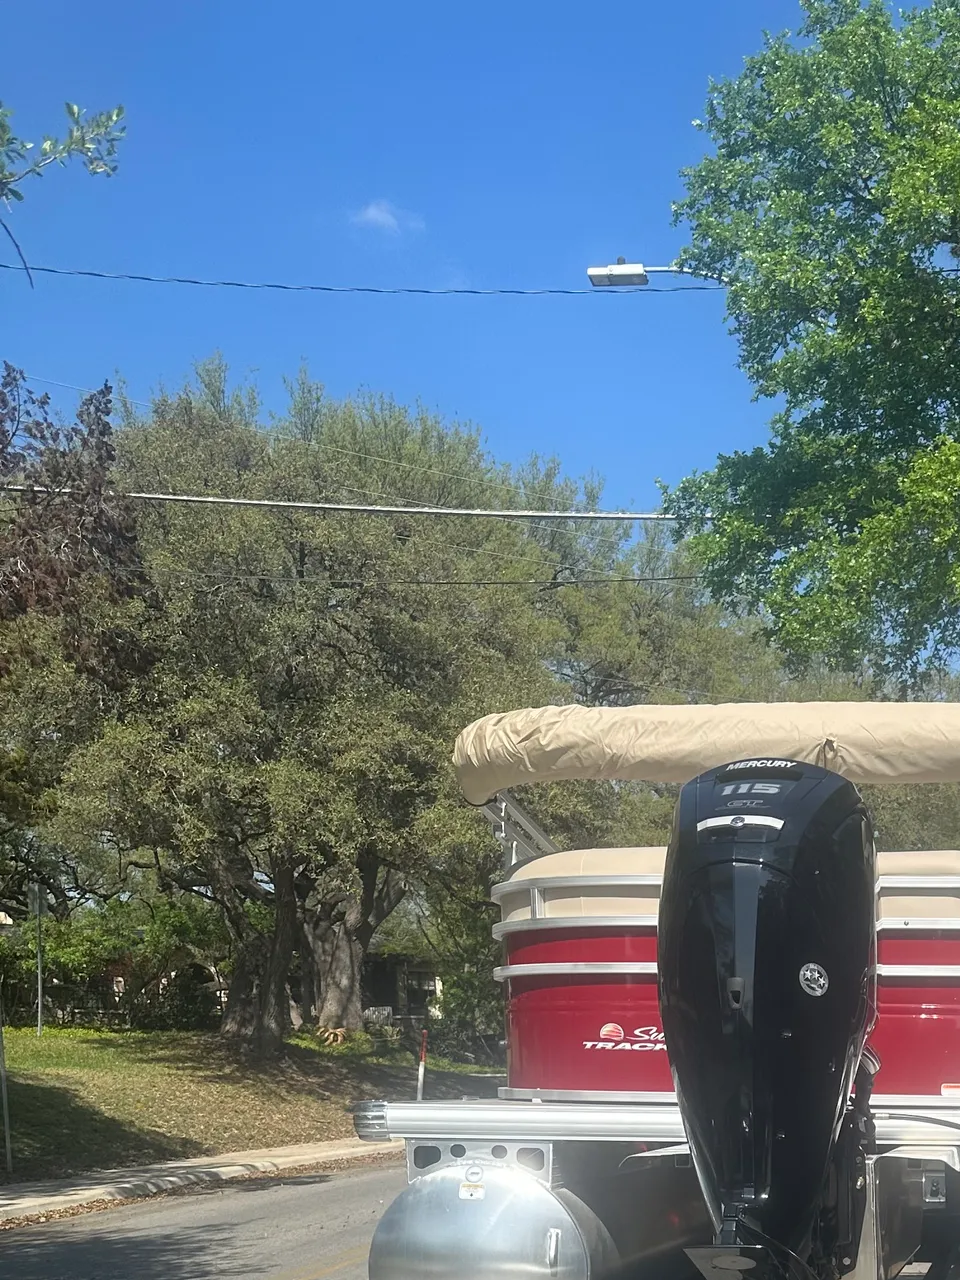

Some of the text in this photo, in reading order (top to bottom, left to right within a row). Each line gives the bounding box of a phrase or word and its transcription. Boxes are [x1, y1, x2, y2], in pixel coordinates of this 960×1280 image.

[726, 760, 798, 771] MERCURY
[721, 783, 782, 796] 115
[626, 1026, 666, 1041] Su
[582, 1041, 668, 1051] TRACK
